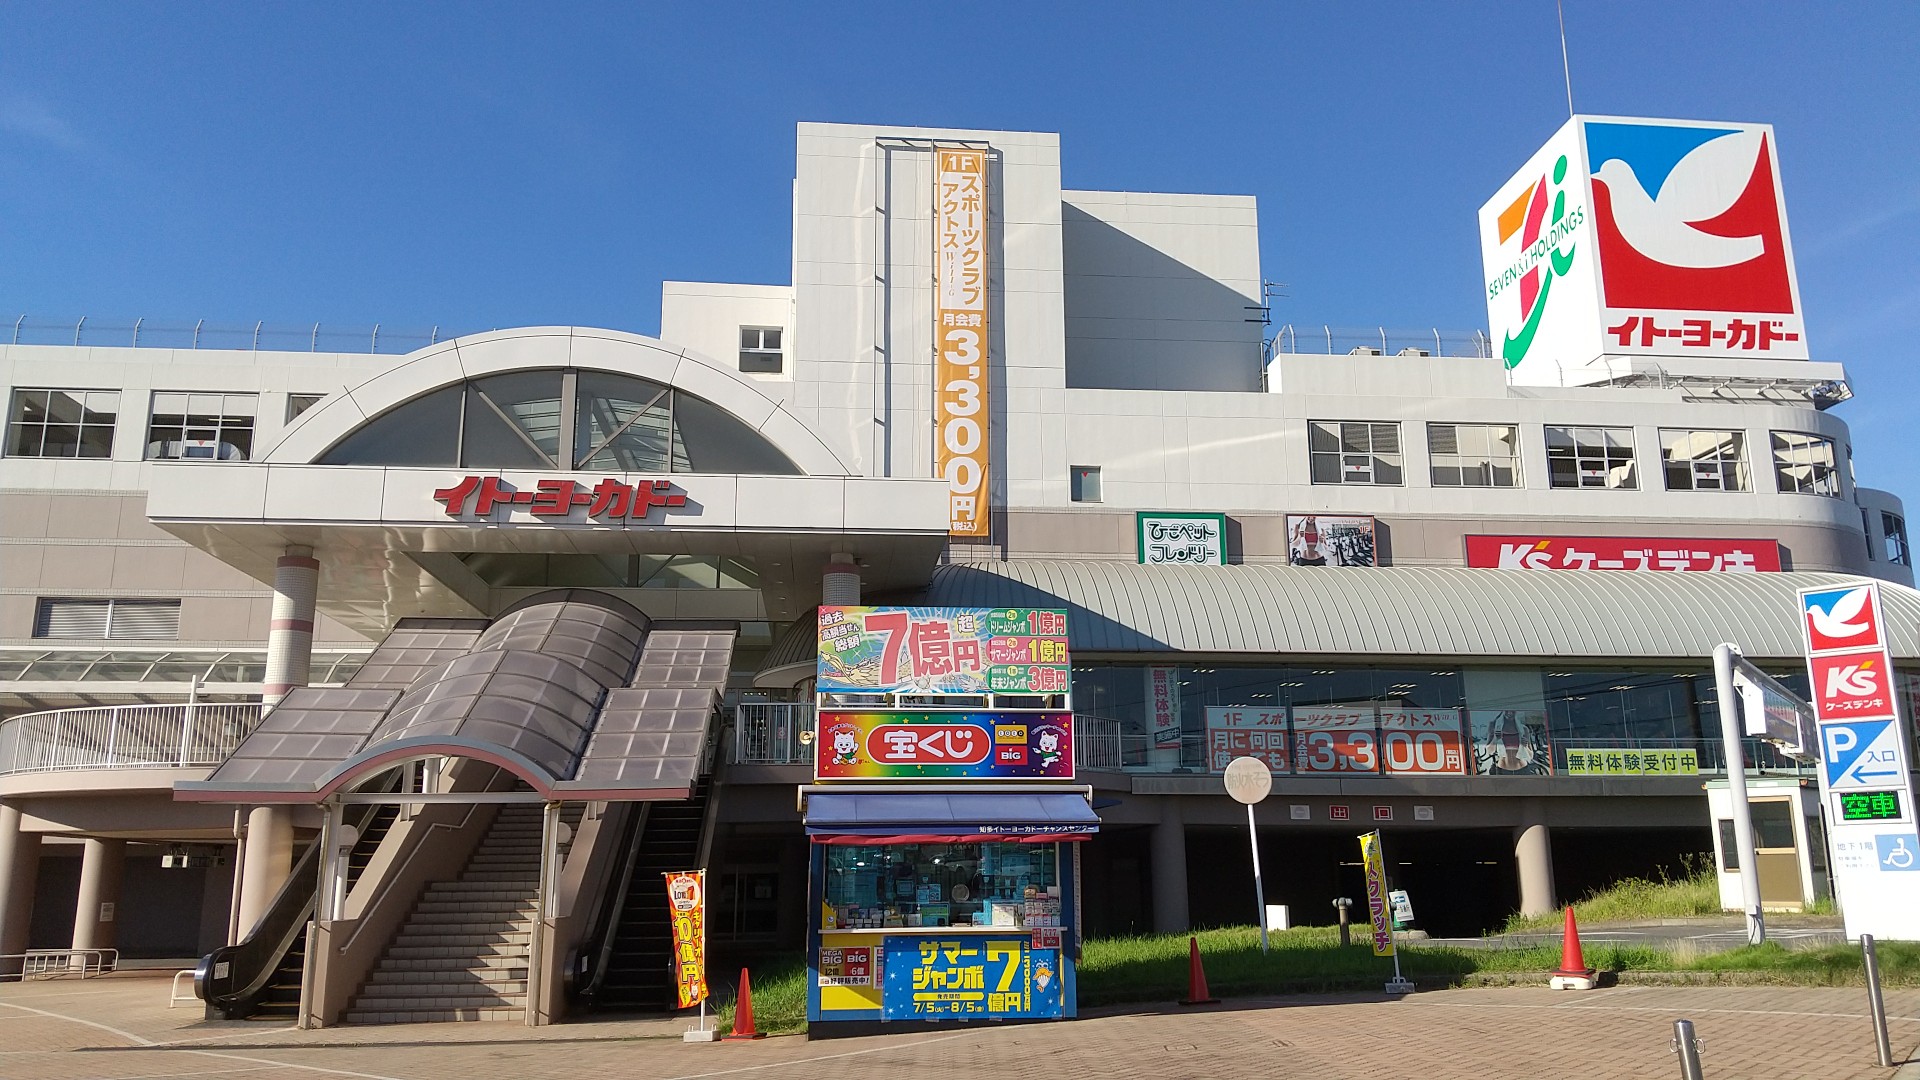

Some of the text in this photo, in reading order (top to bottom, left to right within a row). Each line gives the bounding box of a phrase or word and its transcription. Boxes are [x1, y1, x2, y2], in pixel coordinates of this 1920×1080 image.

[949, 156, 974, 171] 1F
[942, 183, 960, 249] アクトス
[961, 175, 981, 305] スポーツクラブ
[1530, 205, 1584, 261] HOLDINGS
[943, 314, 982, 327] 月会費
[1607, 316, 1799, 351] イトーヨーカドー
[433, 475, 687, 519] イトーヨーカドー
[1562, 547, 1755, 572] ケーズデンキ
[821, 611, 844, 626] 過去
[957, 615, 975, 633] 超
[990, 620, 1026, 634] ドリームジャンボ
[1027, 611, 1066, 635] 1億円
[821, 623, 860, 641] 高額当せん
[834, 634, 860, 653] 総額
[864, 613, 981, 685] 7億円
[990, 649, 1027, 661] サマージャンボ
[1028, 638, 1067, 663] 1億円
[991, 677, 1027, 690] 年末ジャンボ
[1028, 666, 1067, 691] 3億円
[1826, 660, 1877, 698] K's
[1153, 669, 1170, 727] 無料体験
[1826, 698, 1884, 712] ケーズデンキ
[1224, 713, 1242, 726] 1F
[1383, 713, 1435, 727] アクトス
[883, 730, 974, 759] 宝くじ
[1825, 726, 1858, 764] P
[1867, 750, 1896, 763] 入口
[1569, 753, 1697, 771] 無料体験受付中
[1842, 793, 1897, 818] 空車
[847, 951, 867, 963] BIG
[919, 941, 978, 965] サマー
[913, 965, 985, 989] ジャンボ
[985, 941, 1021, 992] 7
[987, 993, 1021, 1012] 億円
